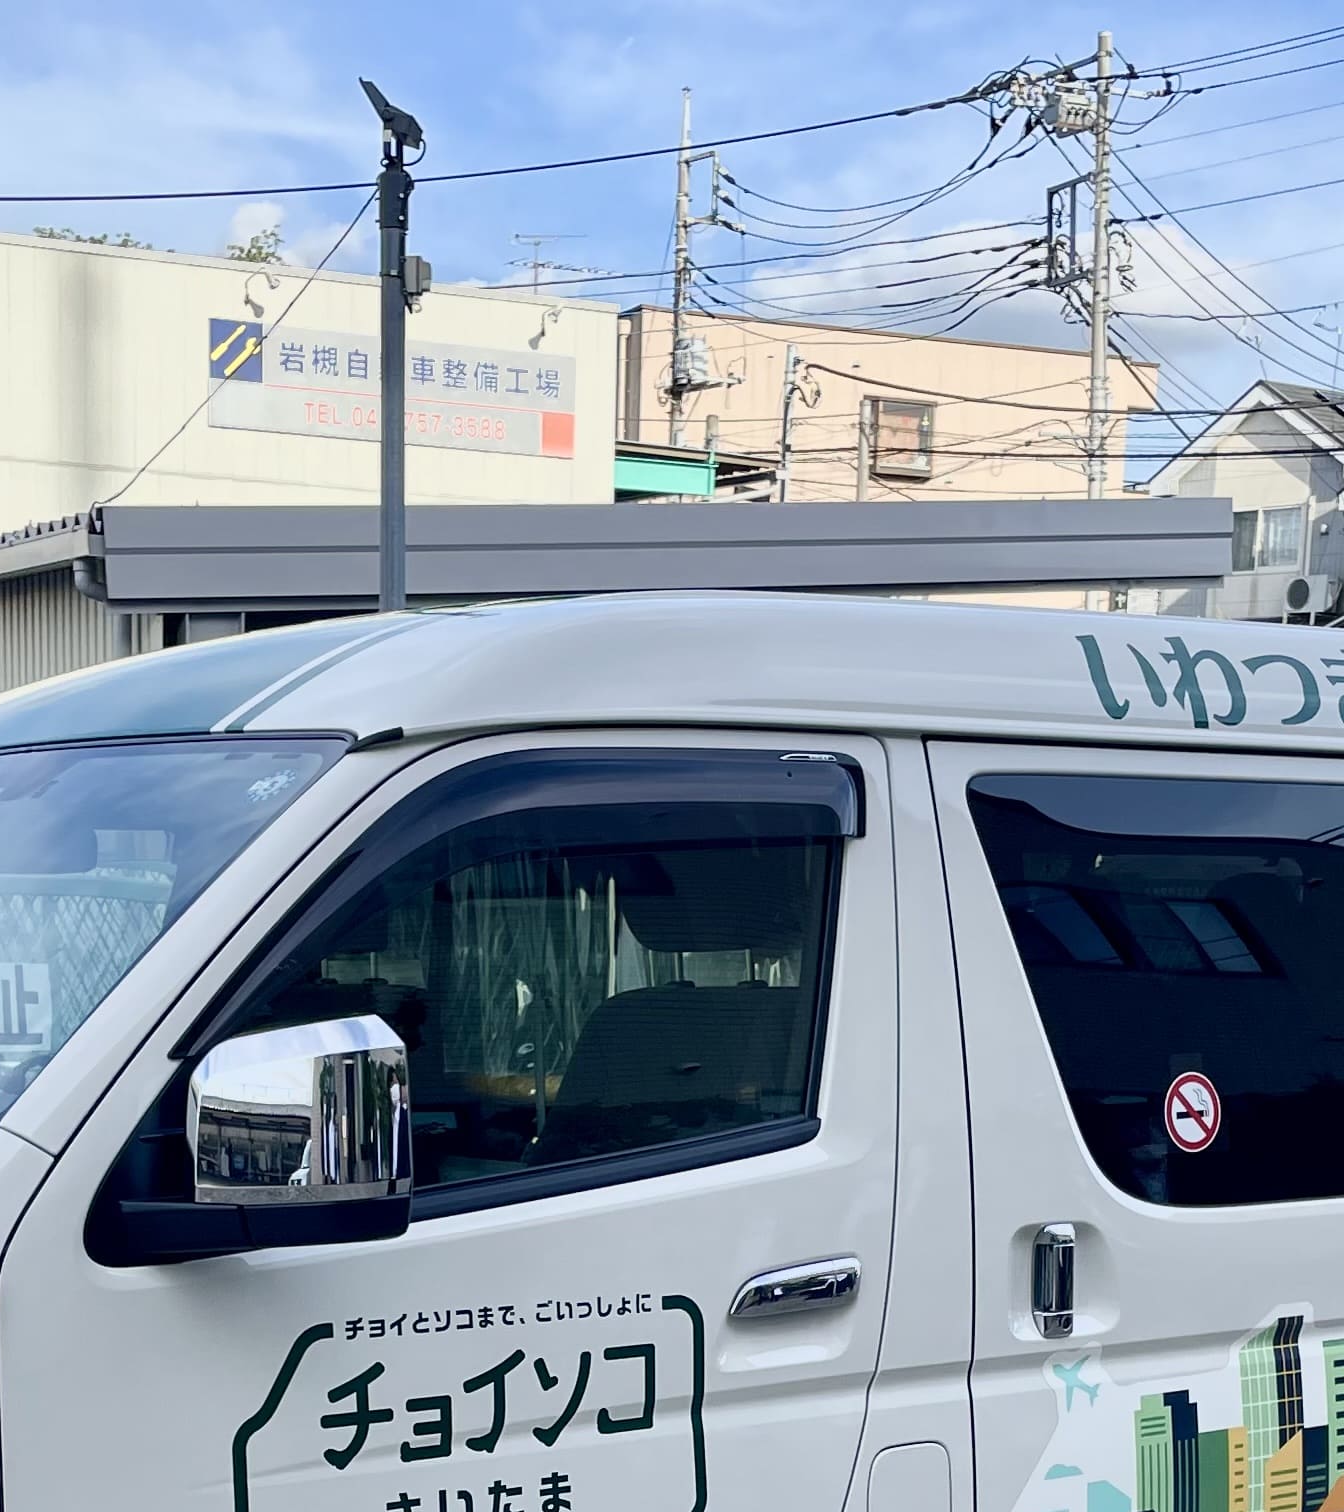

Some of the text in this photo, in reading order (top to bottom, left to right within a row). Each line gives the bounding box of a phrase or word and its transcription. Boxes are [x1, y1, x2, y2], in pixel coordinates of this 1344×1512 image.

[279, 343, 561, 399] 岩槻自車整備工場
[352, 407, 506, 440] 04757-3588
[345, 1293, 652, 1340] チョイとソコまで、ごいっしょに
[319, 1343, 656, 1470] チョイソコ
